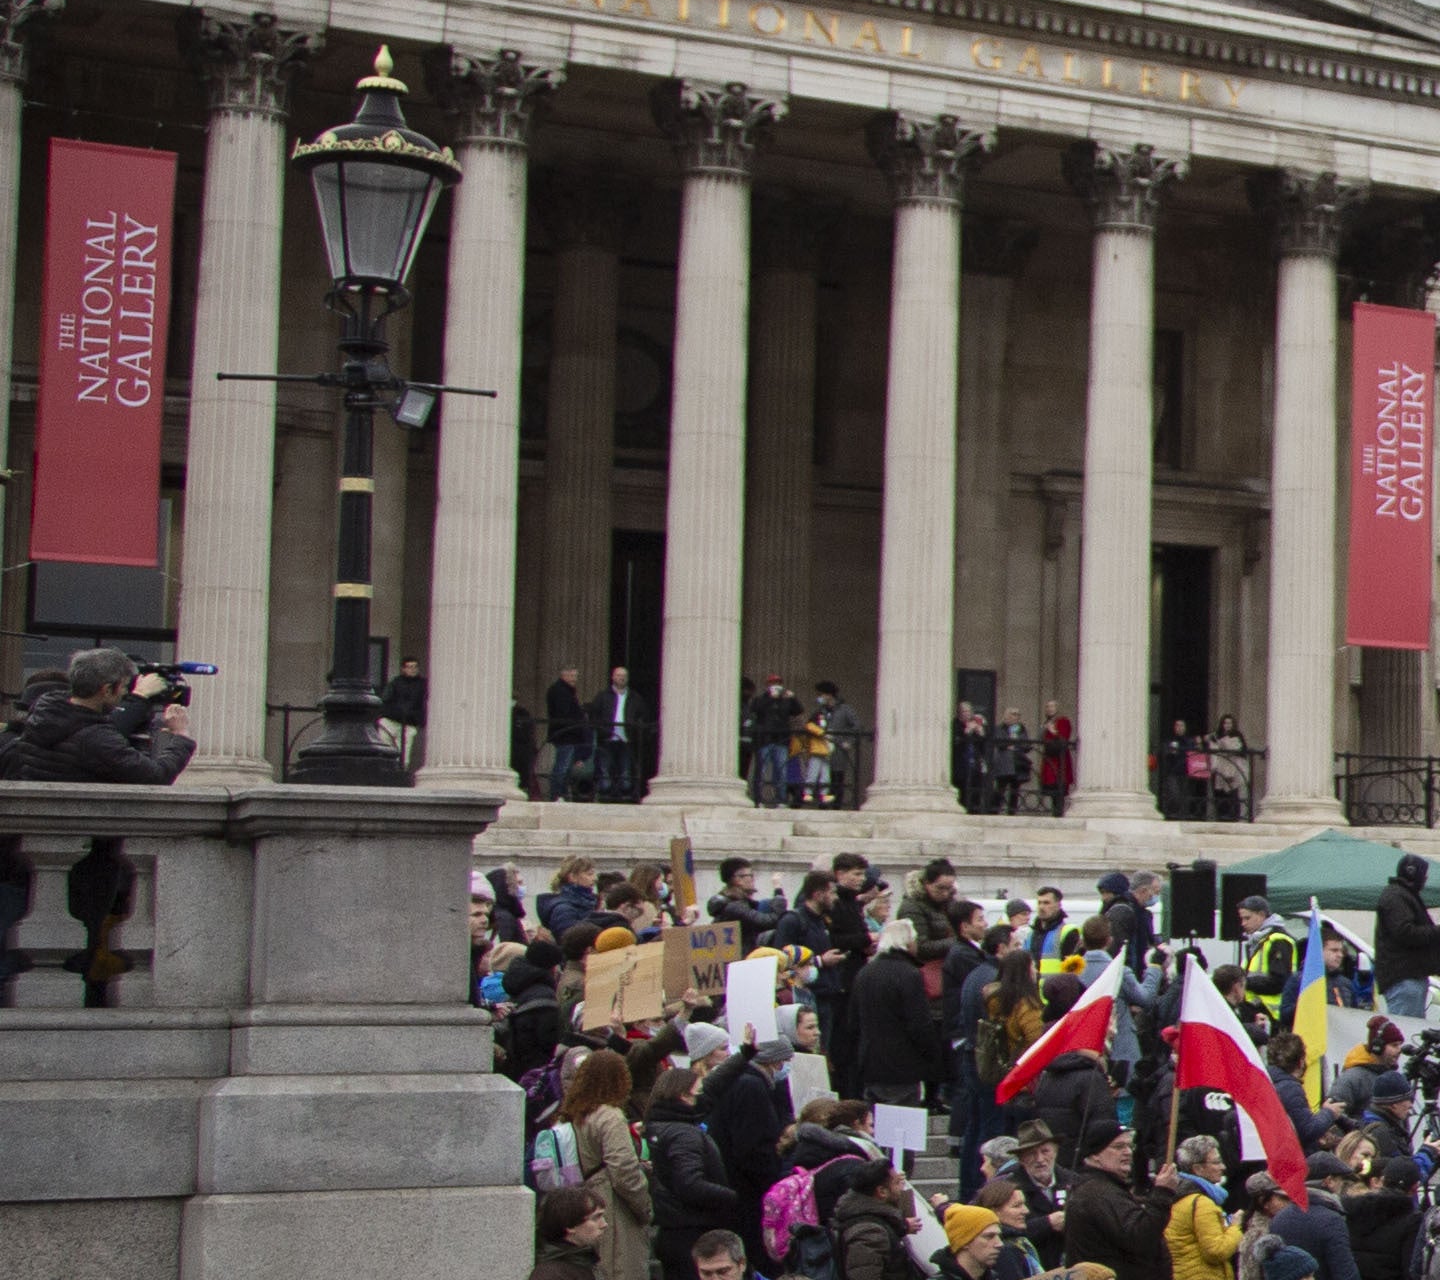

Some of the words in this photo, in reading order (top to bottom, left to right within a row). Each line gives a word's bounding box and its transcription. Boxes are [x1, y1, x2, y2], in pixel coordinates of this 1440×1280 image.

[969, 37, 1246, 109] GALLERY
[58, 313, 76, 351] THE
[77, 210, 118, 404] NATIONAL
[115, 212, 159, 408] GALLERY
[1376, 361, 1399, 517] NATIONAL
[1400, 363, 1426, 521] GALLERY
[692, 964, 723, 990] WA
